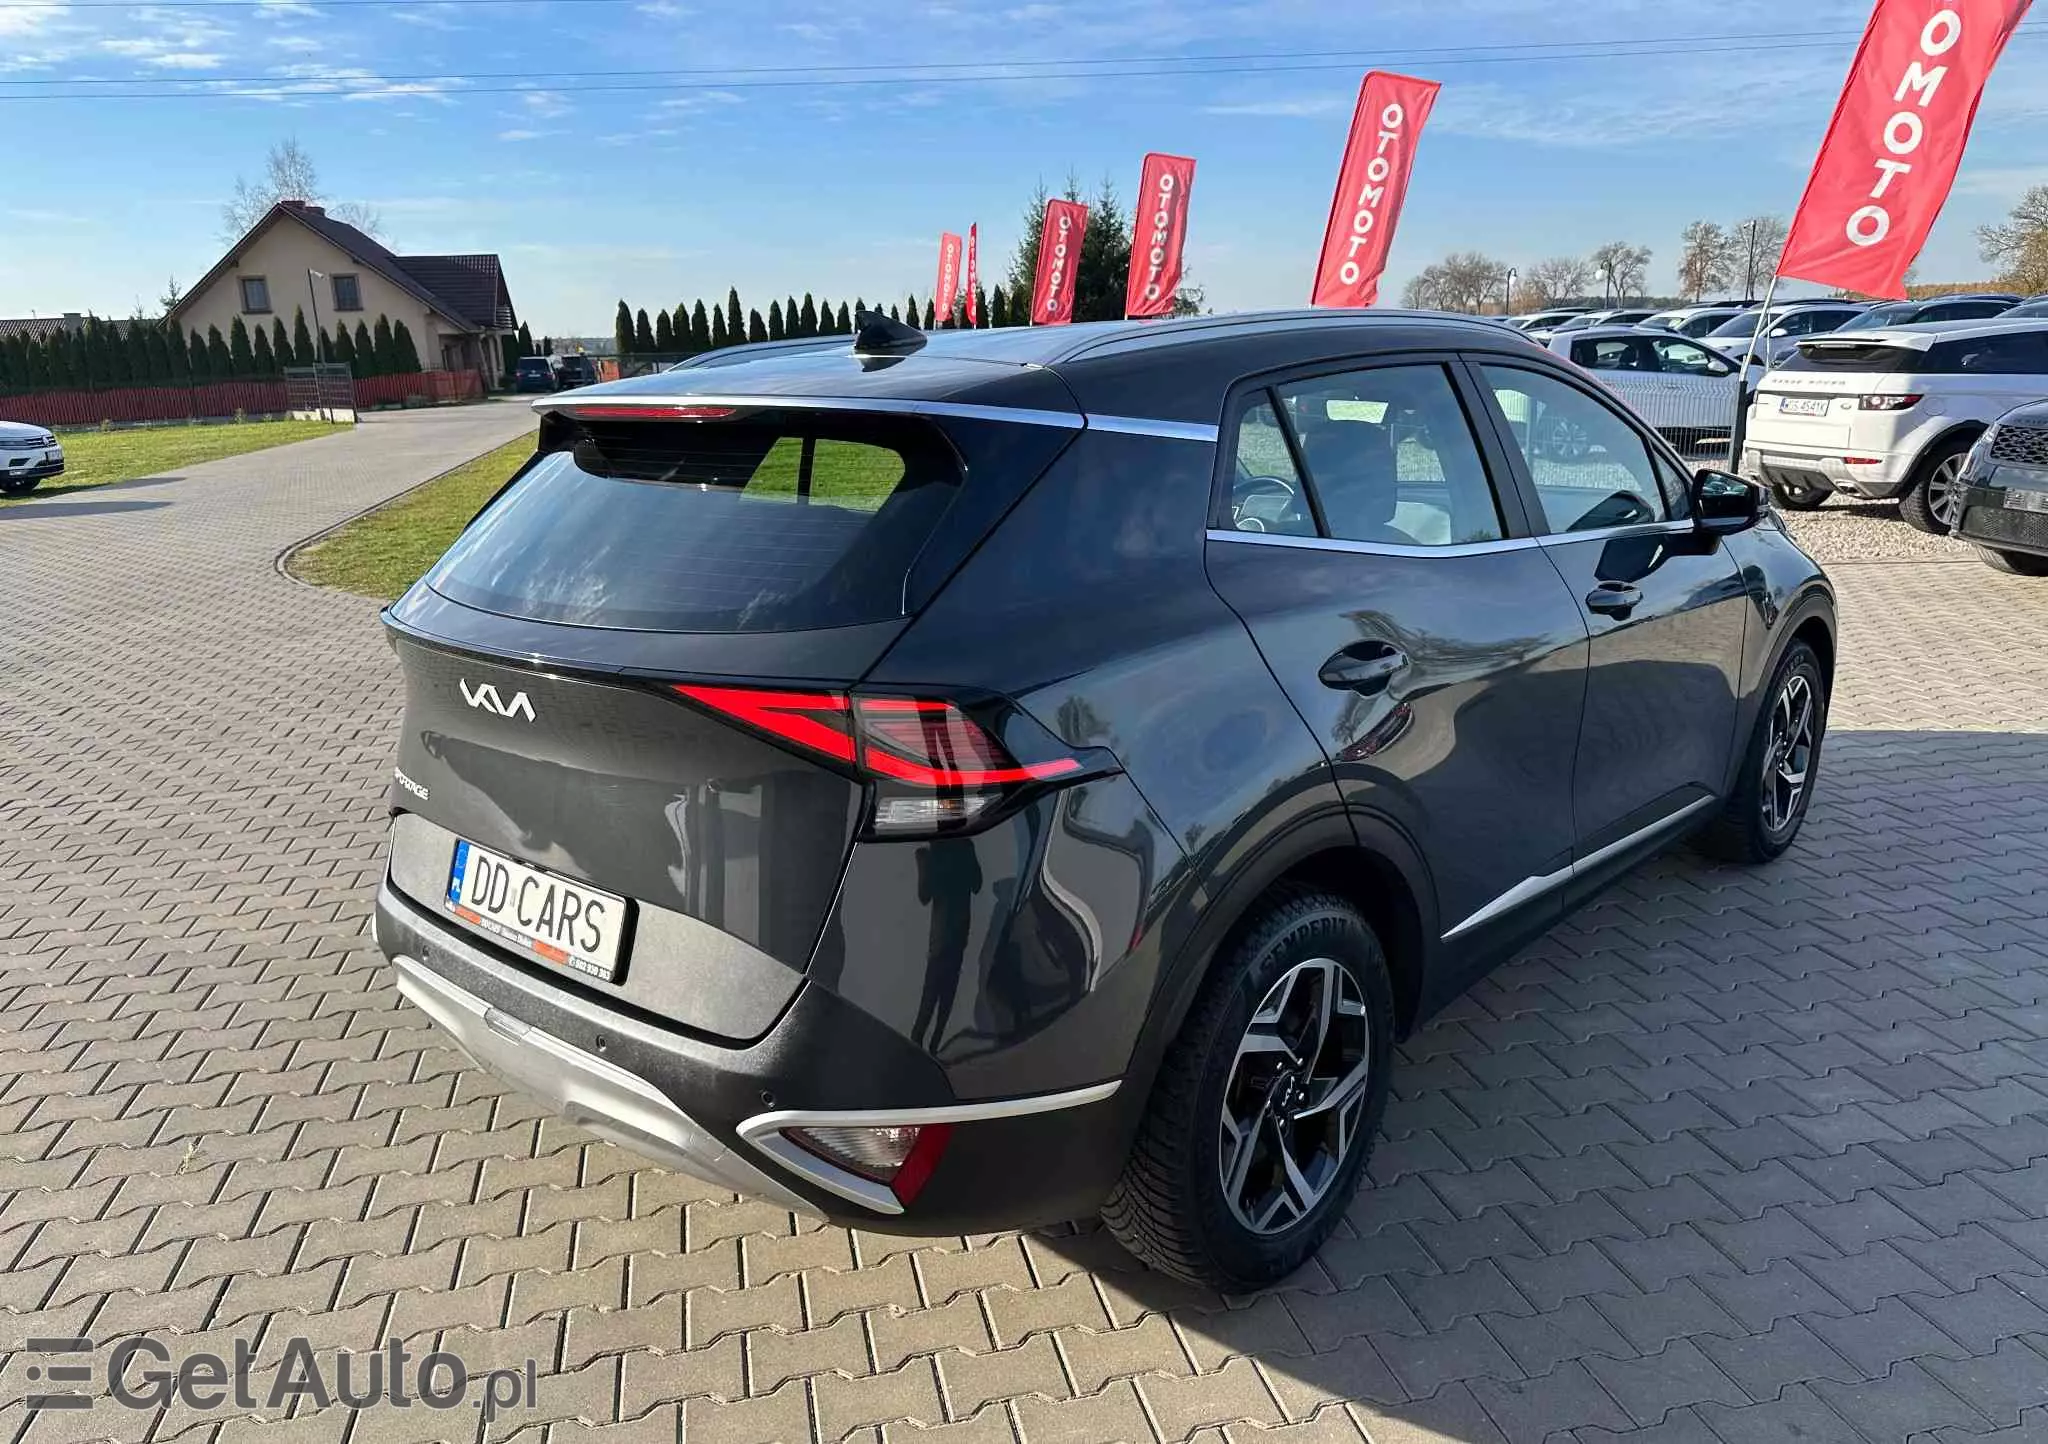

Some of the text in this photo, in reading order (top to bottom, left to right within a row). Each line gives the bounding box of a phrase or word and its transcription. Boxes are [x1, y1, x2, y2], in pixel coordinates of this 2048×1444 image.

[1845, 3, 1962, 247] OMOTO
[1145, 174, 1174, 300] OTOMOTO
[1340, 103, 1404, 284] OTOMOTO
[1047, 216, 1071, 311] OTOMOTO
[459, 678, 537, 723] KIA
[471, 855, 510, 914] DD
[517, 876, 605, 953] CARS
